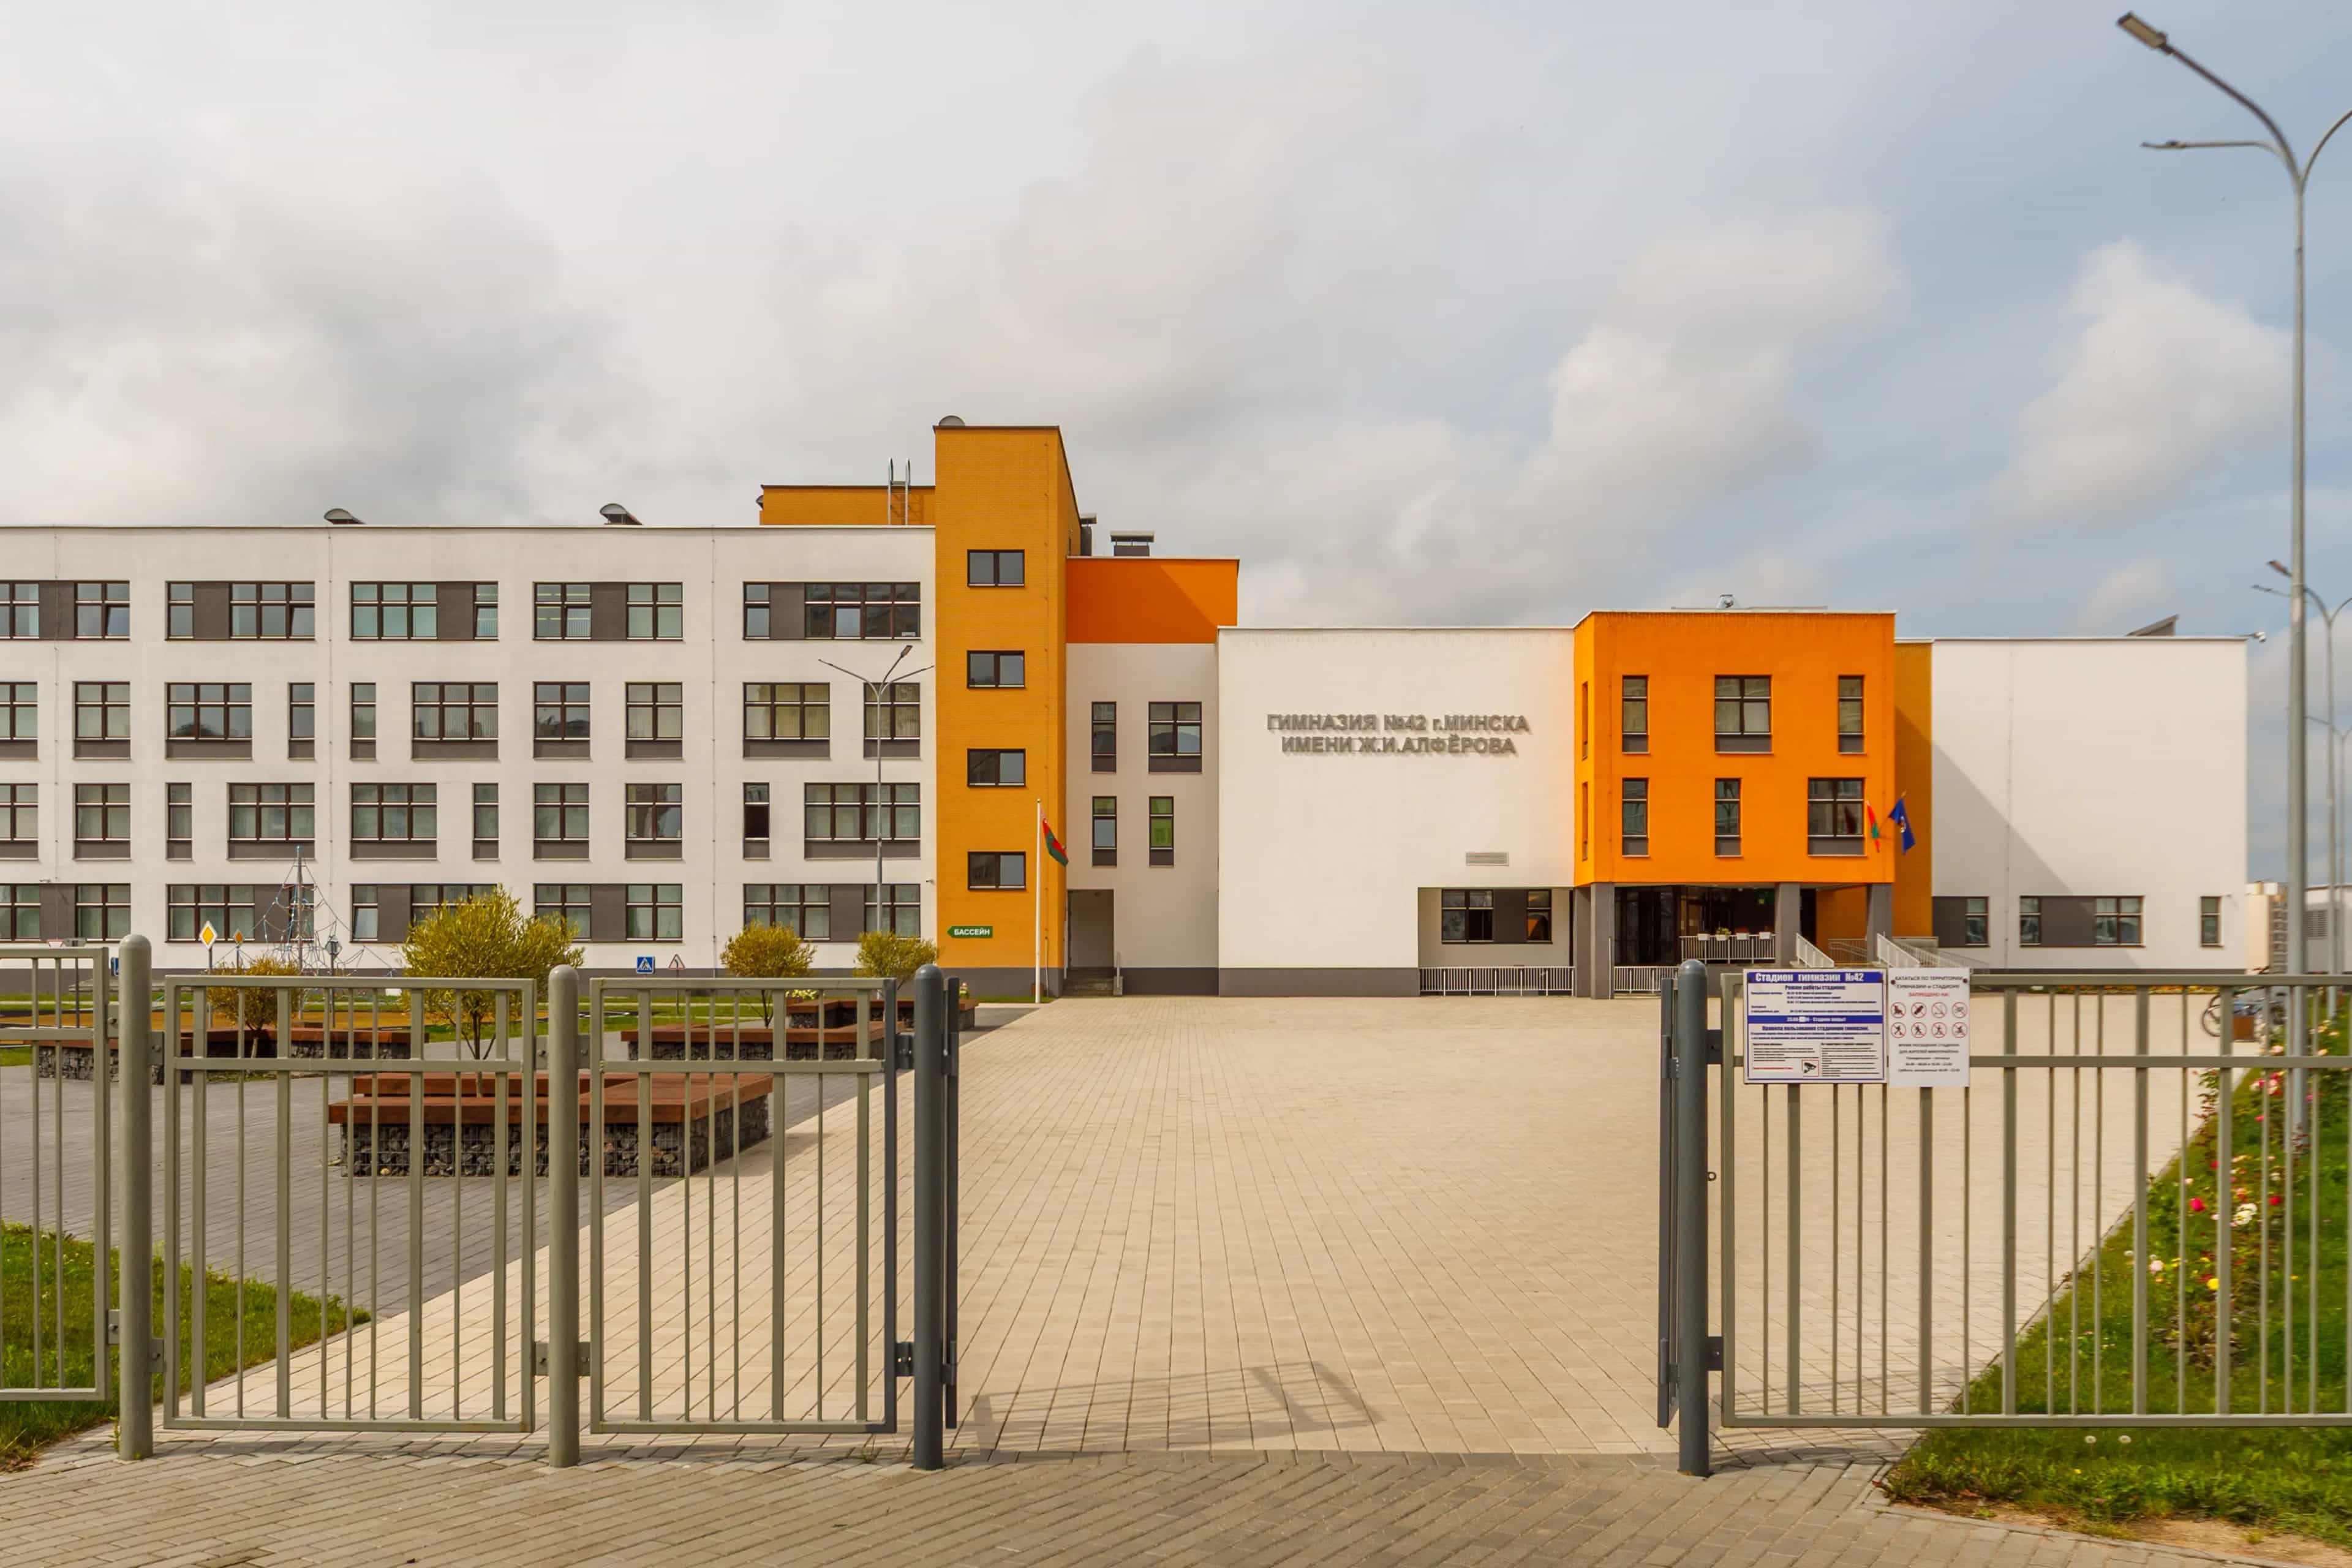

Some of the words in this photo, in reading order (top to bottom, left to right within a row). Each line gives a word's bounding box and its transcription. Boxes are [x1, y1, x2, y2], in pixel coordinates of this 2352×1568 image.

[1267, 714, 1377, 731] ГИМНАЗИЯ
[1384, 715, 1427, 731] №42
[1433, 715, 1529, 731] г.МИНСКА
[1282, 736, 1352, 752] ИМЕНИ
[1358, 734, 1516, 753] Ж.И.АЛФЁРОВА
[1755, 973, 1793, 982] Стадион
[1845, 973, 1864, 981] №42
